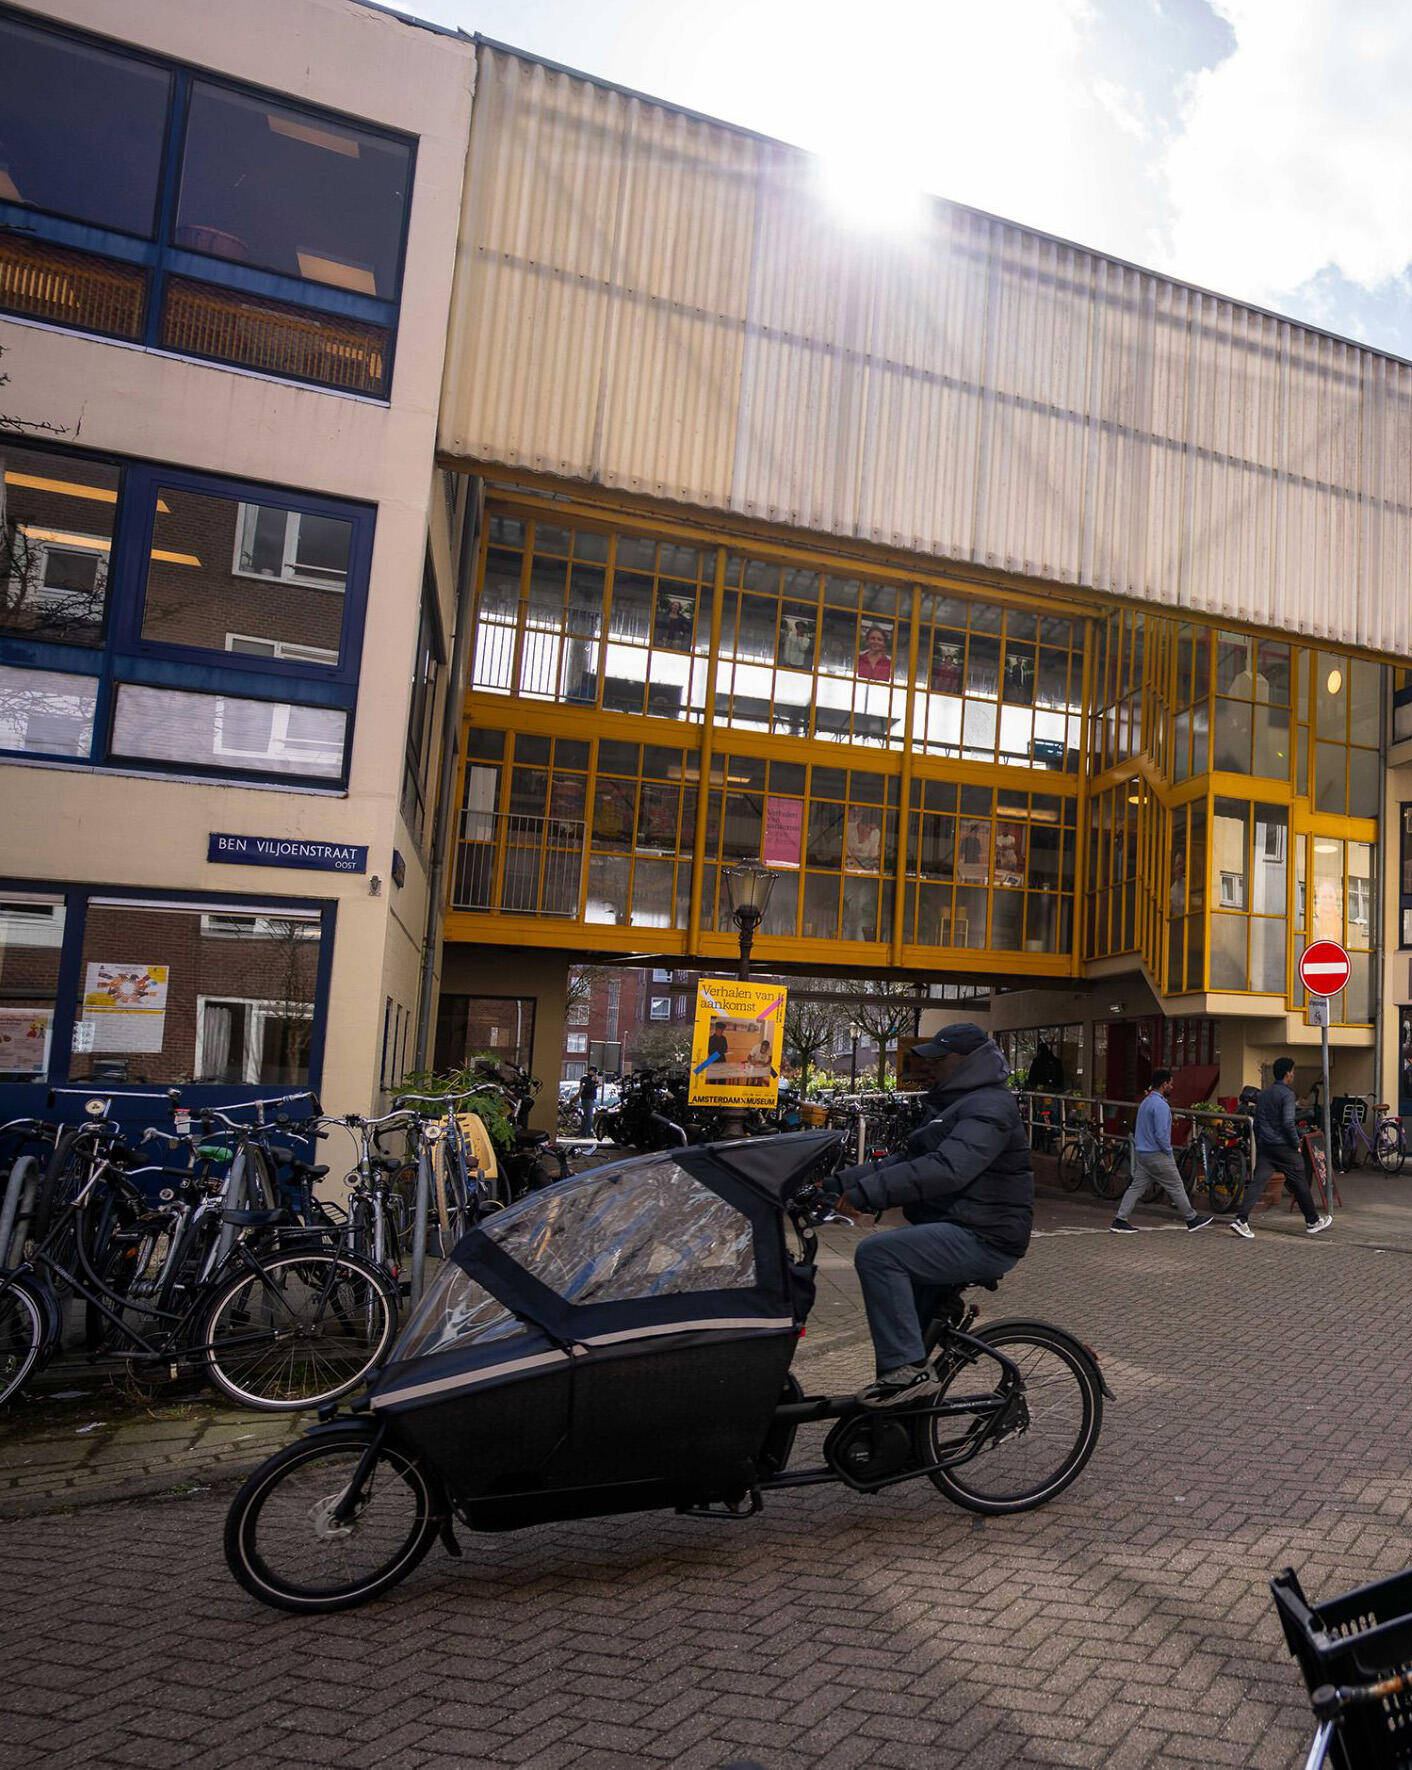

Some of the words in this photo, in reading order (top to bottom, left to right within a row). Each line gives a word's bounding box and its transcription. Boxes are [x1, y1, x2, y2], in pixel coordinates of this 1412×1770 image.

[218, 837, 247, 851] BEN
[256, 840, 358, 860] VILJOENSTRAAT
[335, 860, 357, 869] OOST
[702, 984, 752, 999] Verhalen
[755, 991, 775, 1001] van
[700, 999, 756, 1012] aankomst
